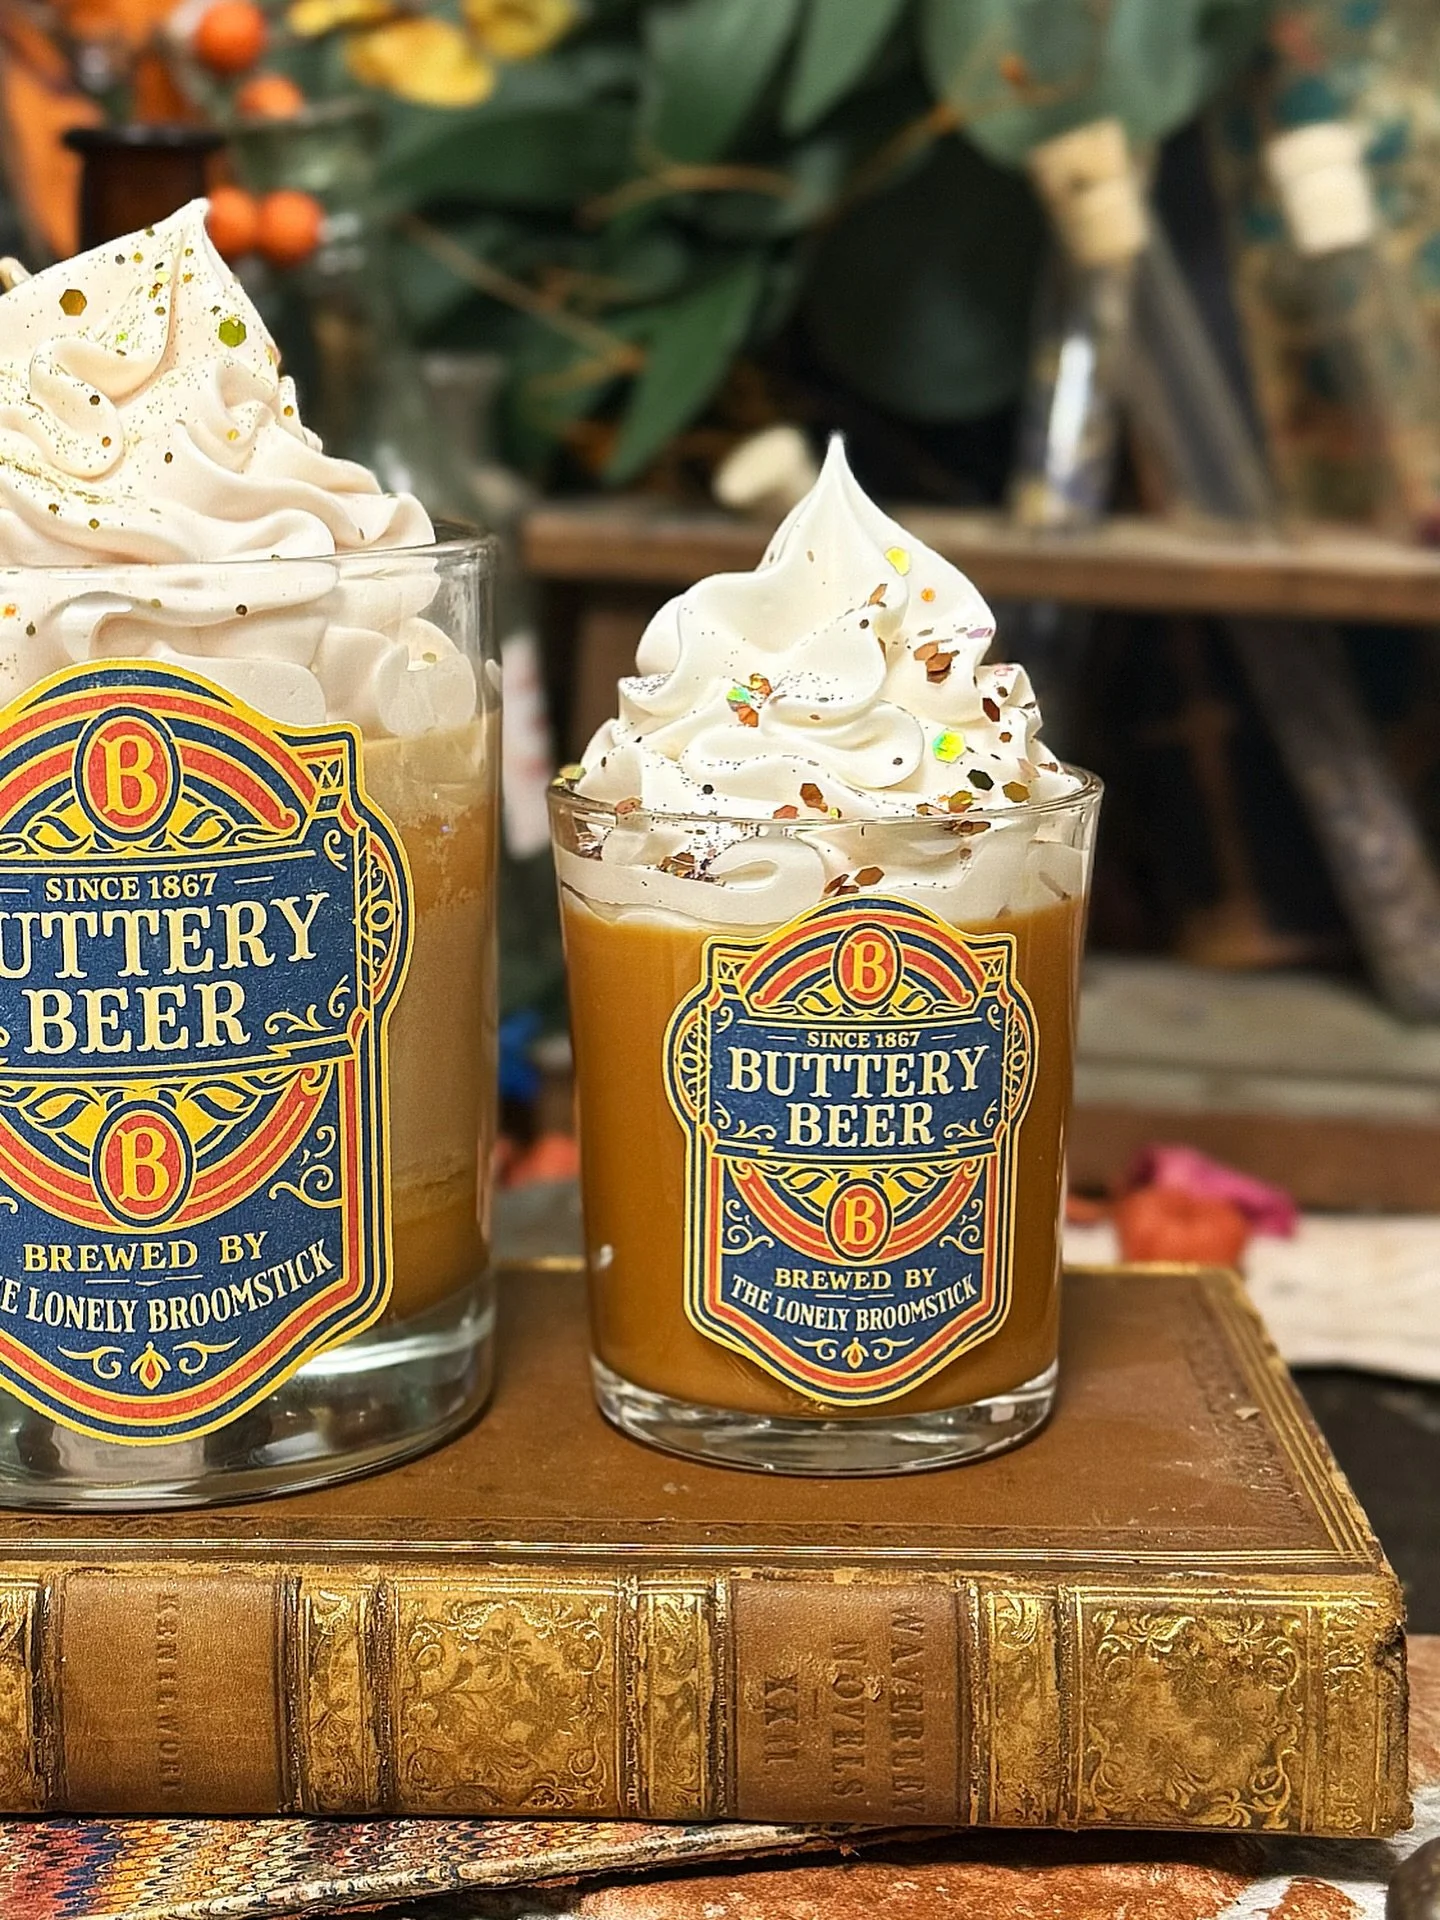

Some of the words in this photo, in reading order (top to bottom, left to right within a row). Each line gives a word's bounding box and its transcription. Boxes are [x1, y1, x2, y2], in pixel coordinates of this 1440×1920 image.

[99, 735, 159, 815] B
[45, 875, 141, 902] SINCE
[147, 872, 219, 900] 1867
[0, 892, 330, 979] UTTERY
[850, 940, 888, 995] B
[22, 980, 252, 1055] BEER
[806, 1031, 871, 1049] SINCE
[874, 1030, 922, 1049] 1867
[726, 1045, 989, 1100] BUTTERY
[785, 1102, 936, 1148] BEER
[116, 1126, 171, 1203] B
[843, 1195, 878, 1246] B
[23, 1239, 199, 1273] BREWED
[218, 1231, 269, 1264] BY
[775, 1267, 892, 1291] BREWED
[904, 1267, 938, 1289] BY
[25, 1287, 138, 1334] LONELY
[147, 1239, 336, 1335] BROOMSTICK
[729, 1274, 770, 1311] THE
[773, 1295, 851, 1332] LONELY
[855, 1274, 978, 1332] BROOMSTICK
[831, 1640, 868, 1797] NOVELS
[891, 1609, 927, 1814] WAVERLEY
